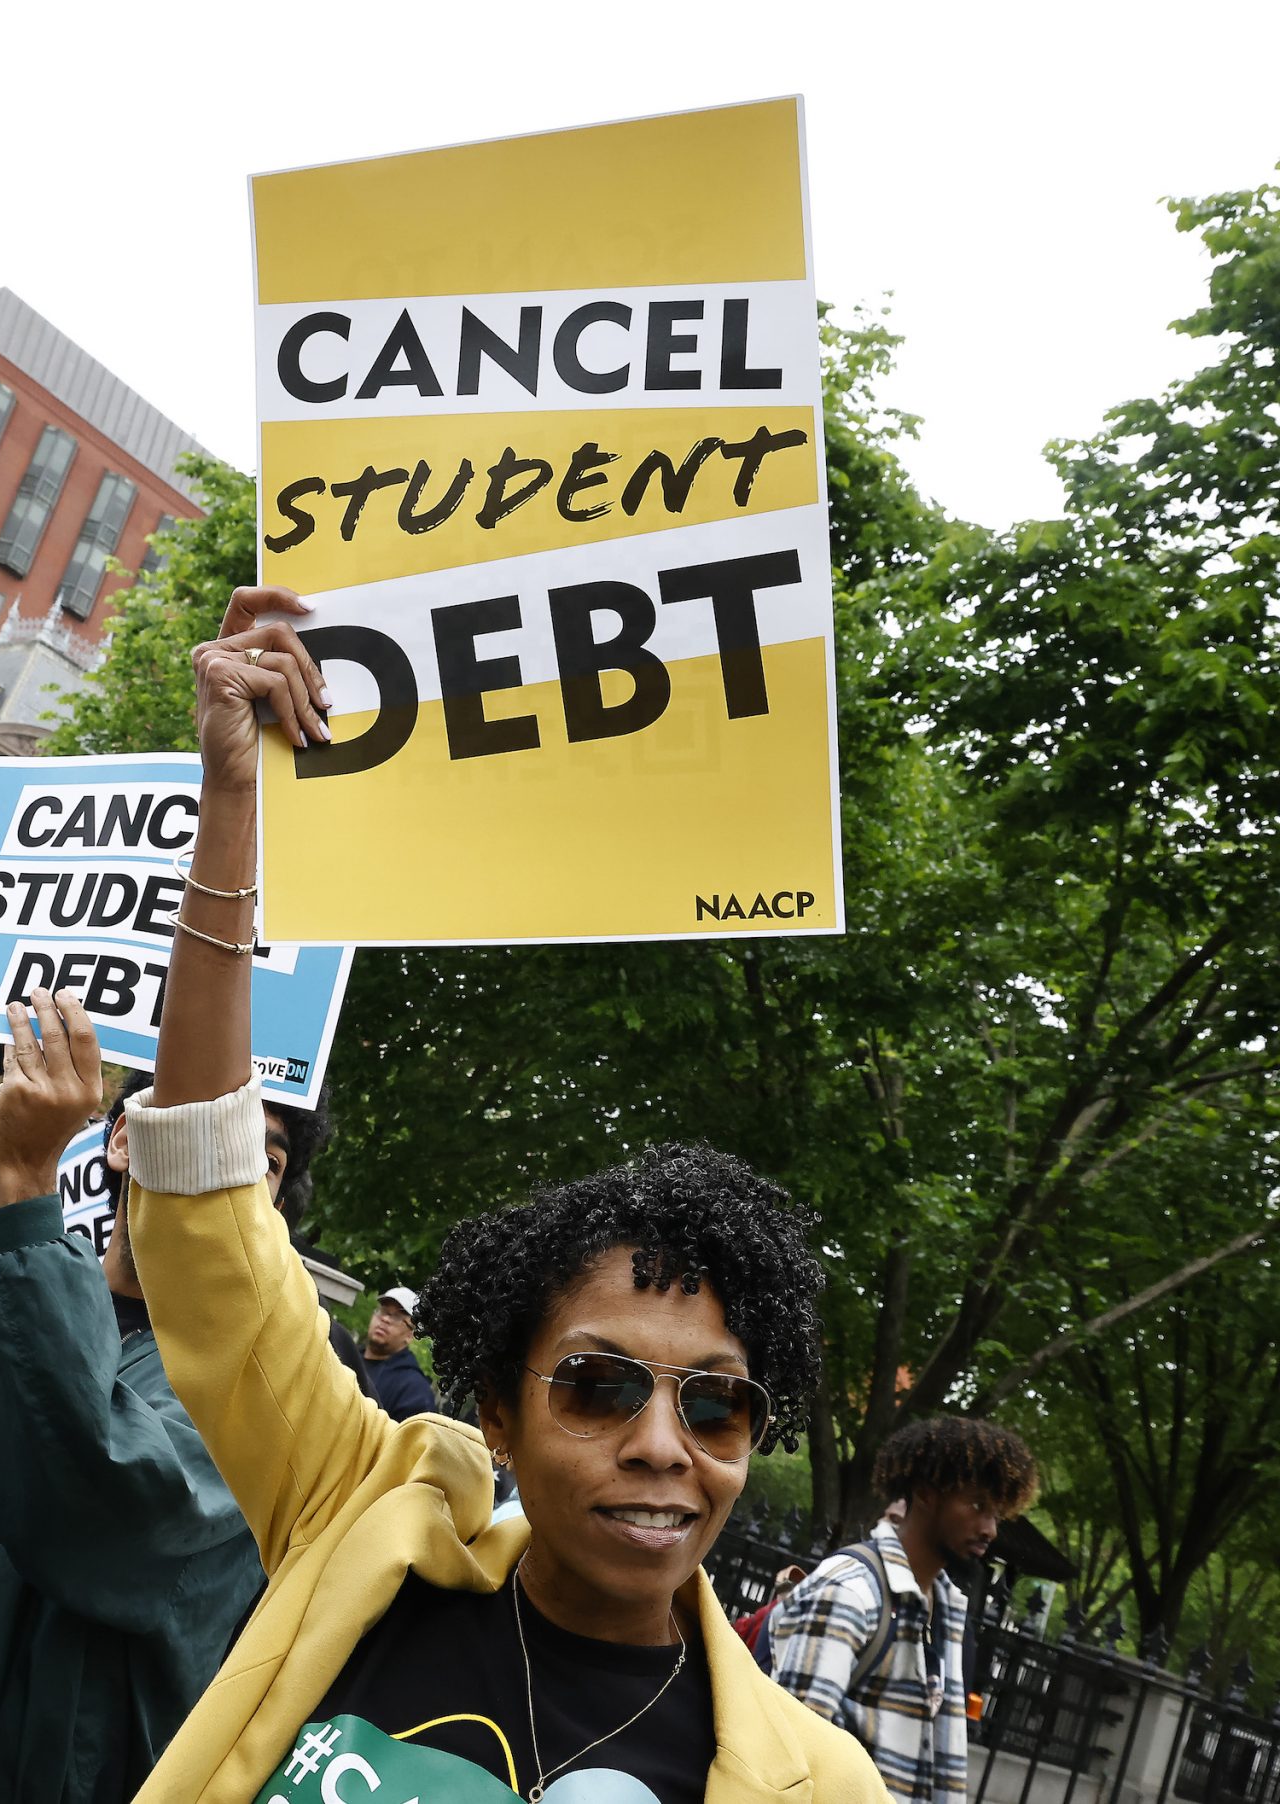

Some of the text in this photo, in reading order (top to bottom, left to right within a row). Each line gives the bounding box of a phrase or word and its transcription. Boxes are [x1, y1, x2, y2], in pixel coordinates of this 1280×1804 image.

[277, 298, 783, 403] CANCEL
[264, 426, 808, 554] STUDENT
[294, 548, 802, 780] DEBT
[17, 793, 200, 850] CANC
[696, 891, 815, 921] NAACP
[253, 1061, 306, 1080] OVEON
